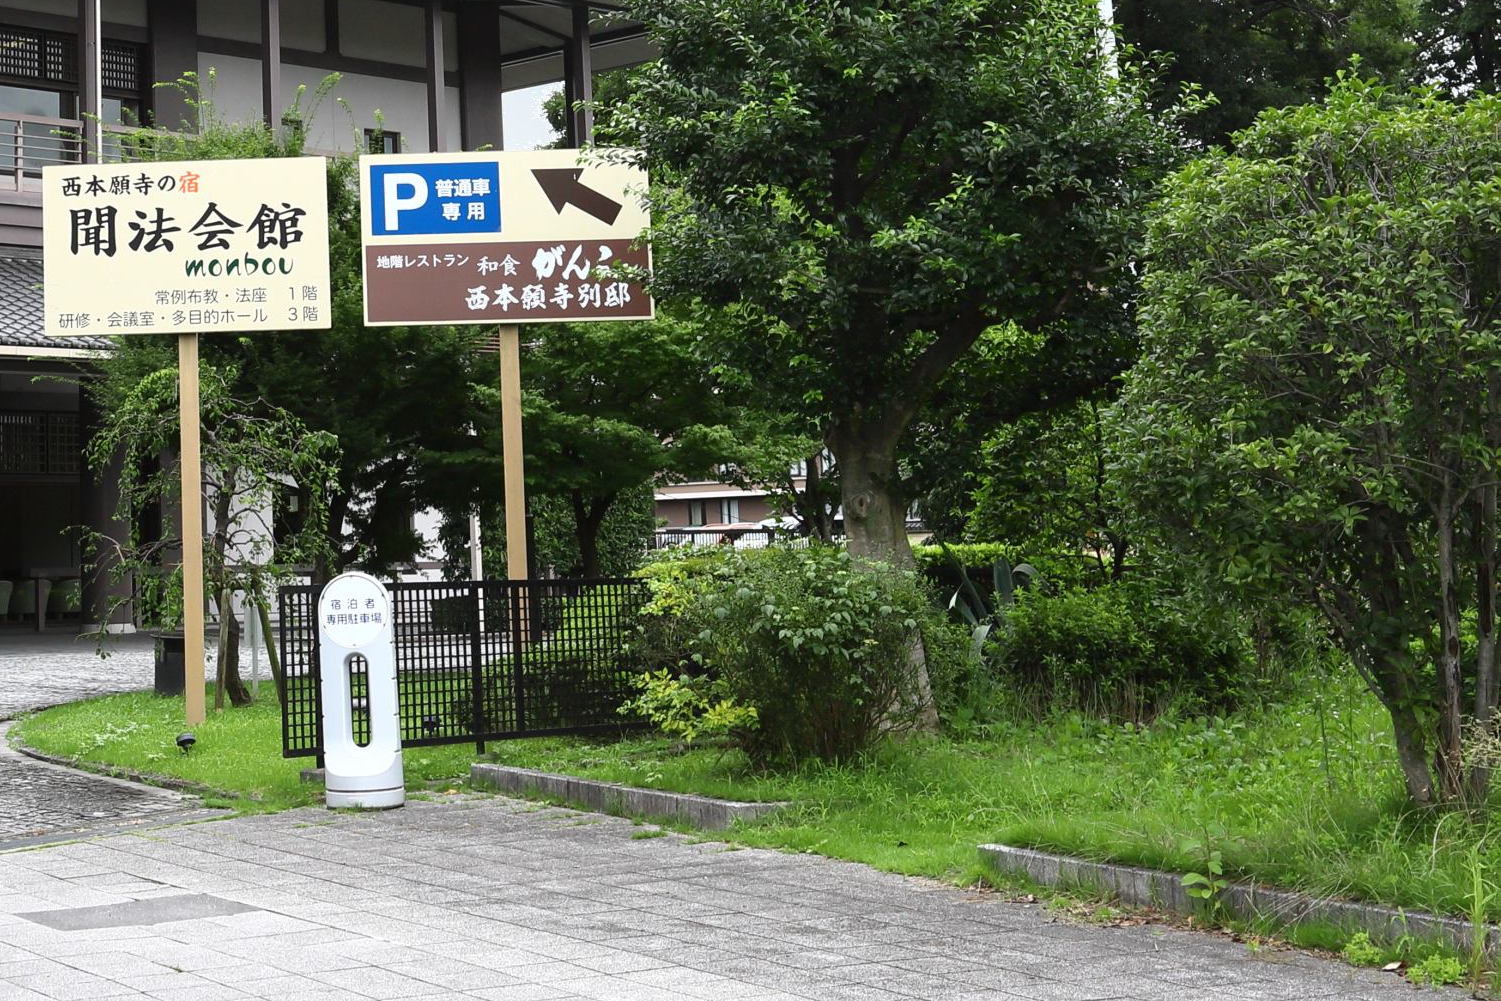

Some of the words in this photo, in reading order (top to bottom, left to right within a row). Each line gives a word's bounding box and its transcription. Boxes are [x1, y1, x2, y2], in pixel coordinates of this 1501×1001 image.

[61, 170, 201, 198] 西本願寺の宿
[435, 178, 491, 197] 普通車
[383, 173, 429, 231] P
[441, 202, 485, 221] 専用
[69, 202, 307, 257] 聞法会館
[185, 252, 294, 277] monbou
[376, 254, 470, 269] 地階レストラン
[476, 254, 521, 276] 和食
[154, 287, 268, 305] 常例布教・法座
[464, 282, 631, 312] 西本願寺別邸
[58, 308, 268, 329] 研修・会議室・多目的ホール
[331, 598, 375, 610] 宿泊者
[326, 613, 382, 625] 専用駐車場
